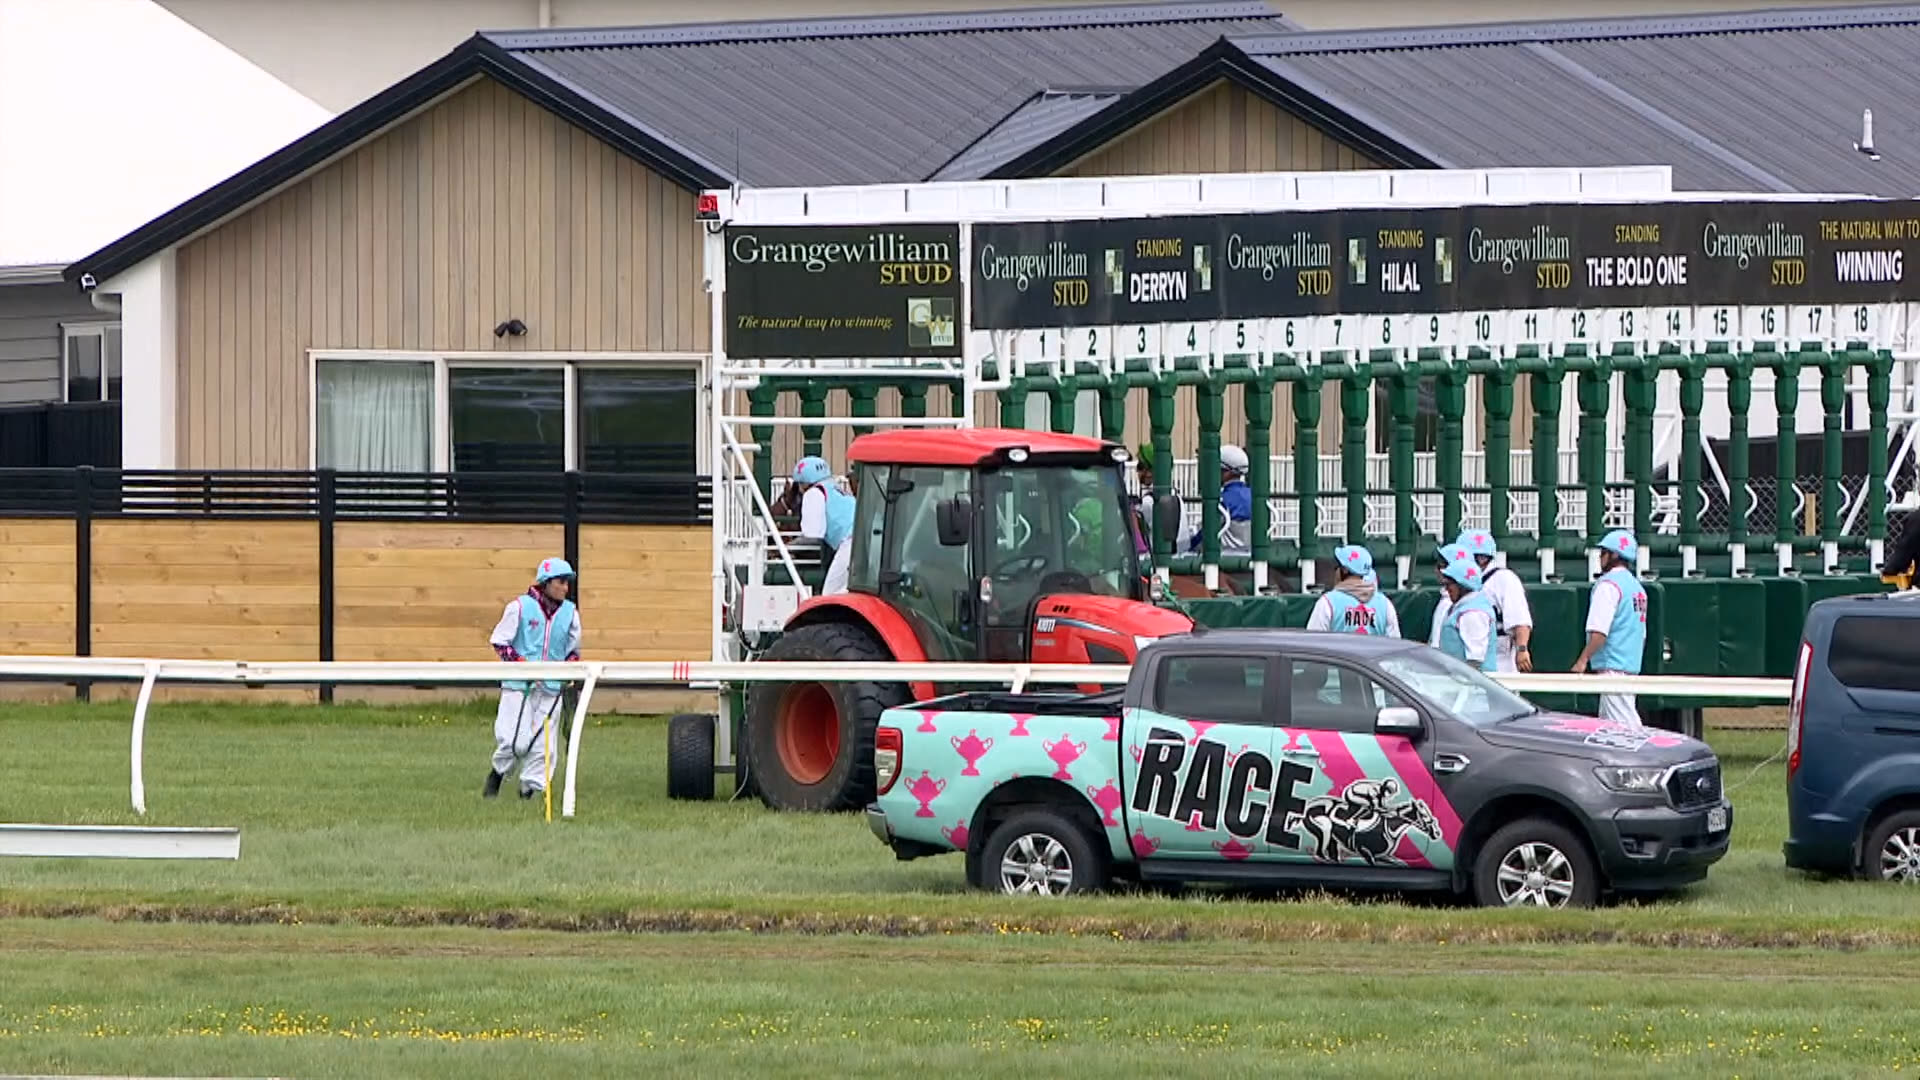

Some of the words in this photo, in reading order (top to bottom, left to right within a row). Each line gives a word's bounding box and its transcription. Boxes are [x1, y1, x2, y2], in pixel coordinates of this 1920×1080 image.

[1378, 230, 1424, 249] STANDING
[1615, 224, 1659, 243] STANDING
[1820, 221, 1838, 240] THE
[1841, 220, 1881, 239] NATURAL
[1883, 220, 1904, 238] WAY
[1906, 219, 1920, 238] TO
[732, 233, 950, 273] Grangewilliam
[1136, 238, 1182, 258] STANDING
[1227, 231, 1331, 281] Grangewilliam
[1469, 225, 1569, 274] Grangewilliam
[1704, 222, 1804, 270] Grangewilliam
[880, 263, 952, 285] STUD
[981, 241, 1088, 292] Grangewilliam
[1381, 262, 1421, 292] HILAL
[1536, 263, 1570, 288] STUD
[1586, 257, 1613, 287] THE
[1617, 256, 1654, 286] BOLD
[1656, 255, 1687, 285] ONE
[1771, 260, 1805, 285] STUD
[1836, 250, 1903, 282] WINNING
[1053, 280, 1088, 306] STUD
[1130, 271, 1187, 303] DERRYN
[1298, 270, 1331, 296] STUD
[738, 316, 758, 328] The
[761, 315, 802, 328] natural
[805, 319, 826, 331] way
[830, 317, 841, 328] to
[1334, 319, 1342, 345] 7
[1382, 317, 1391, 344] 8
[1430, 316, 1439, 341] 9
[1475, 314, 1490, 341] 10
[1524, 313, 1537, 339] 11
[1571, 312, 1586, 338] 12
[1619, 310, 1634, 336] 13
[1666, 309, 1680, 336] 14
[1713, 309, 1728, 335] 15
[1760, 308, 1774, 334] 16
[1808, 307, 1822, 333] 17
[1854, 306, 1867, 332] 18
[1039, 331, 1046, 358] 1
[1088, 328, 1097, 356] 2
[1137, 326, 1146, 353] 3
[1187, 324, 1196, 351] 4
[1236, 323, 1245, 348] 5
[1285, 321, 1294, 347] 6
[1345, 610, 1376, 628] RACE
[1132, 727, 1317, 850] RACE
